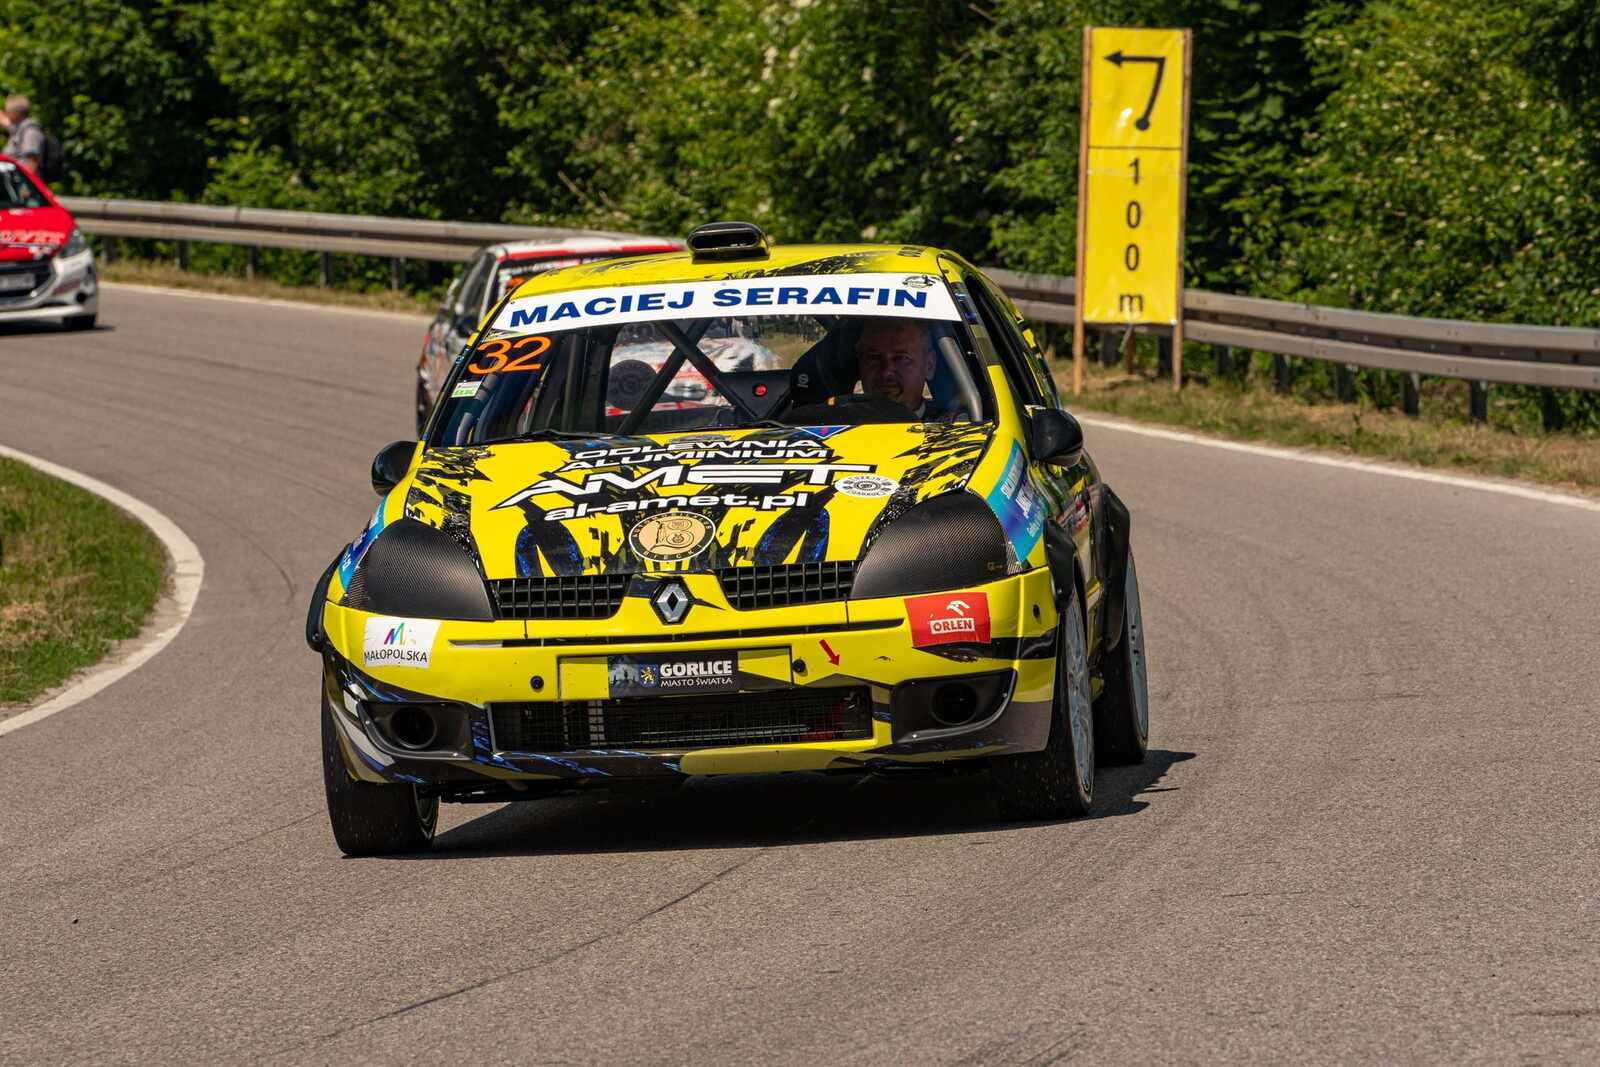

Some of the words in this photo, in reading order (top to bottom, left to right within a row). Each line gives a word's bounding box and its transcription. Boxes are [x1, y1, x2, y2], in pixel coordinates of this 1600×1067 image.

[509, 290, 695, 328] MACIEJ
[712, 287, 928, 309] SERAFIN
[468, 336, 552, 375] 32
[559, 449, 828, 472] ALUMINIUM
[574, 440, 821, 460] ODLEWNIA
[496, 464, 872, 508] AMET
[543, 492, 809, 522] al-amet.pl
[932, 620, 972, 632] ORLEN
[364, 648, 428, 662] MAŁOPOLSKA
[660, 660, 732, 677] GORLICE
[660, 678, 694, 688] MIASTO
[696, 677, 733, 686] ŚWIATŁA
